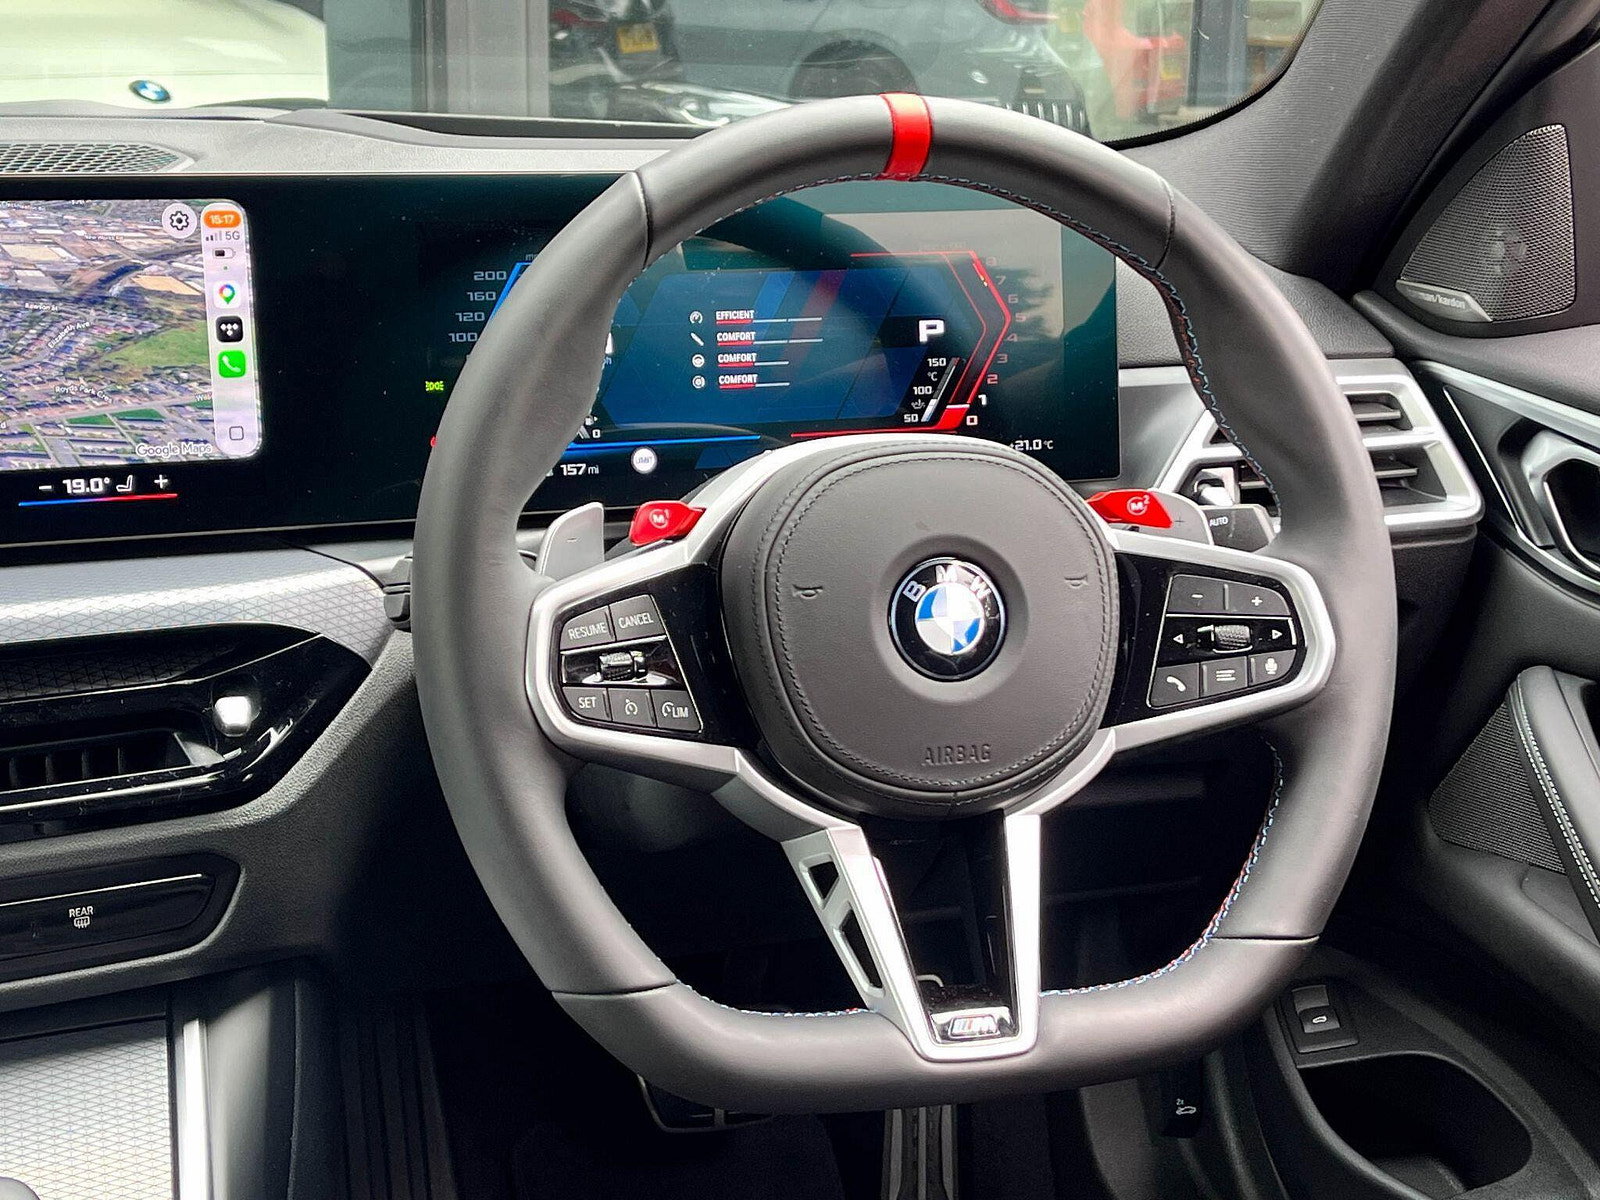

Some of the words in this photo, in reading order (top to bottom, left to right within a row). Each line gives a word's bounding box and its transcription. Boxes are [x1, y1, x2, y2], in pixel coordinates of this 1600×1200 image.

[210, 214, 235, 225] 15:17
[225, 231, 240, 240] 5G
[473, 271, 507, 281] 200
[996, 275, 1006, 285] 7
[467, 291, 496, 301] 160
[1008, 294, 1018, 303] 6
[456, 311, 485, 322] 120
[716, 310, 755, 320] EFFICIENT
[1015, 313, 1027, 322] 5
[76, 321, 90, 330] Ave
[448, 332, 478, 342] 100
[716, 331, 756, 342] COMFORT
[918, 319, 945, 344] P
[1006, 333, 1018, 342] 4
[717, 352, 757, 363] COMFORT
[927, 357, 946, 367] 150
[997, 354, 1007, 363] 3
[718, 373, 758, 384] COMFORT
[987, 374, 998, 384] 2
[79, 386, 95, 394] Park
[912, 385, 933, 395] 100
[978, 394, 987, 406] 1
[903, 413, 919, 423] 50
[966, 415, 978, 426] 0
[592, 429, 601, 438] 0
[136, 442, 180, 458] Google
[181, 442, 213, 456] Maps
[560, 463, 587, 476] 157
[588, 465, 600, 475] mi
[1209, 516, 1229, 527] AUTO
[902, 564, 992, 602] BMW
[618, 613, 653, 629] CANCEL
[568, 622, 607, 640] RESUME
[578, 697, 597, 709] SET
[672, 707, 689, 719] LIM
[923, 743, 992, 766] AIRBAG
[68, 905, 94, 918] REAR
